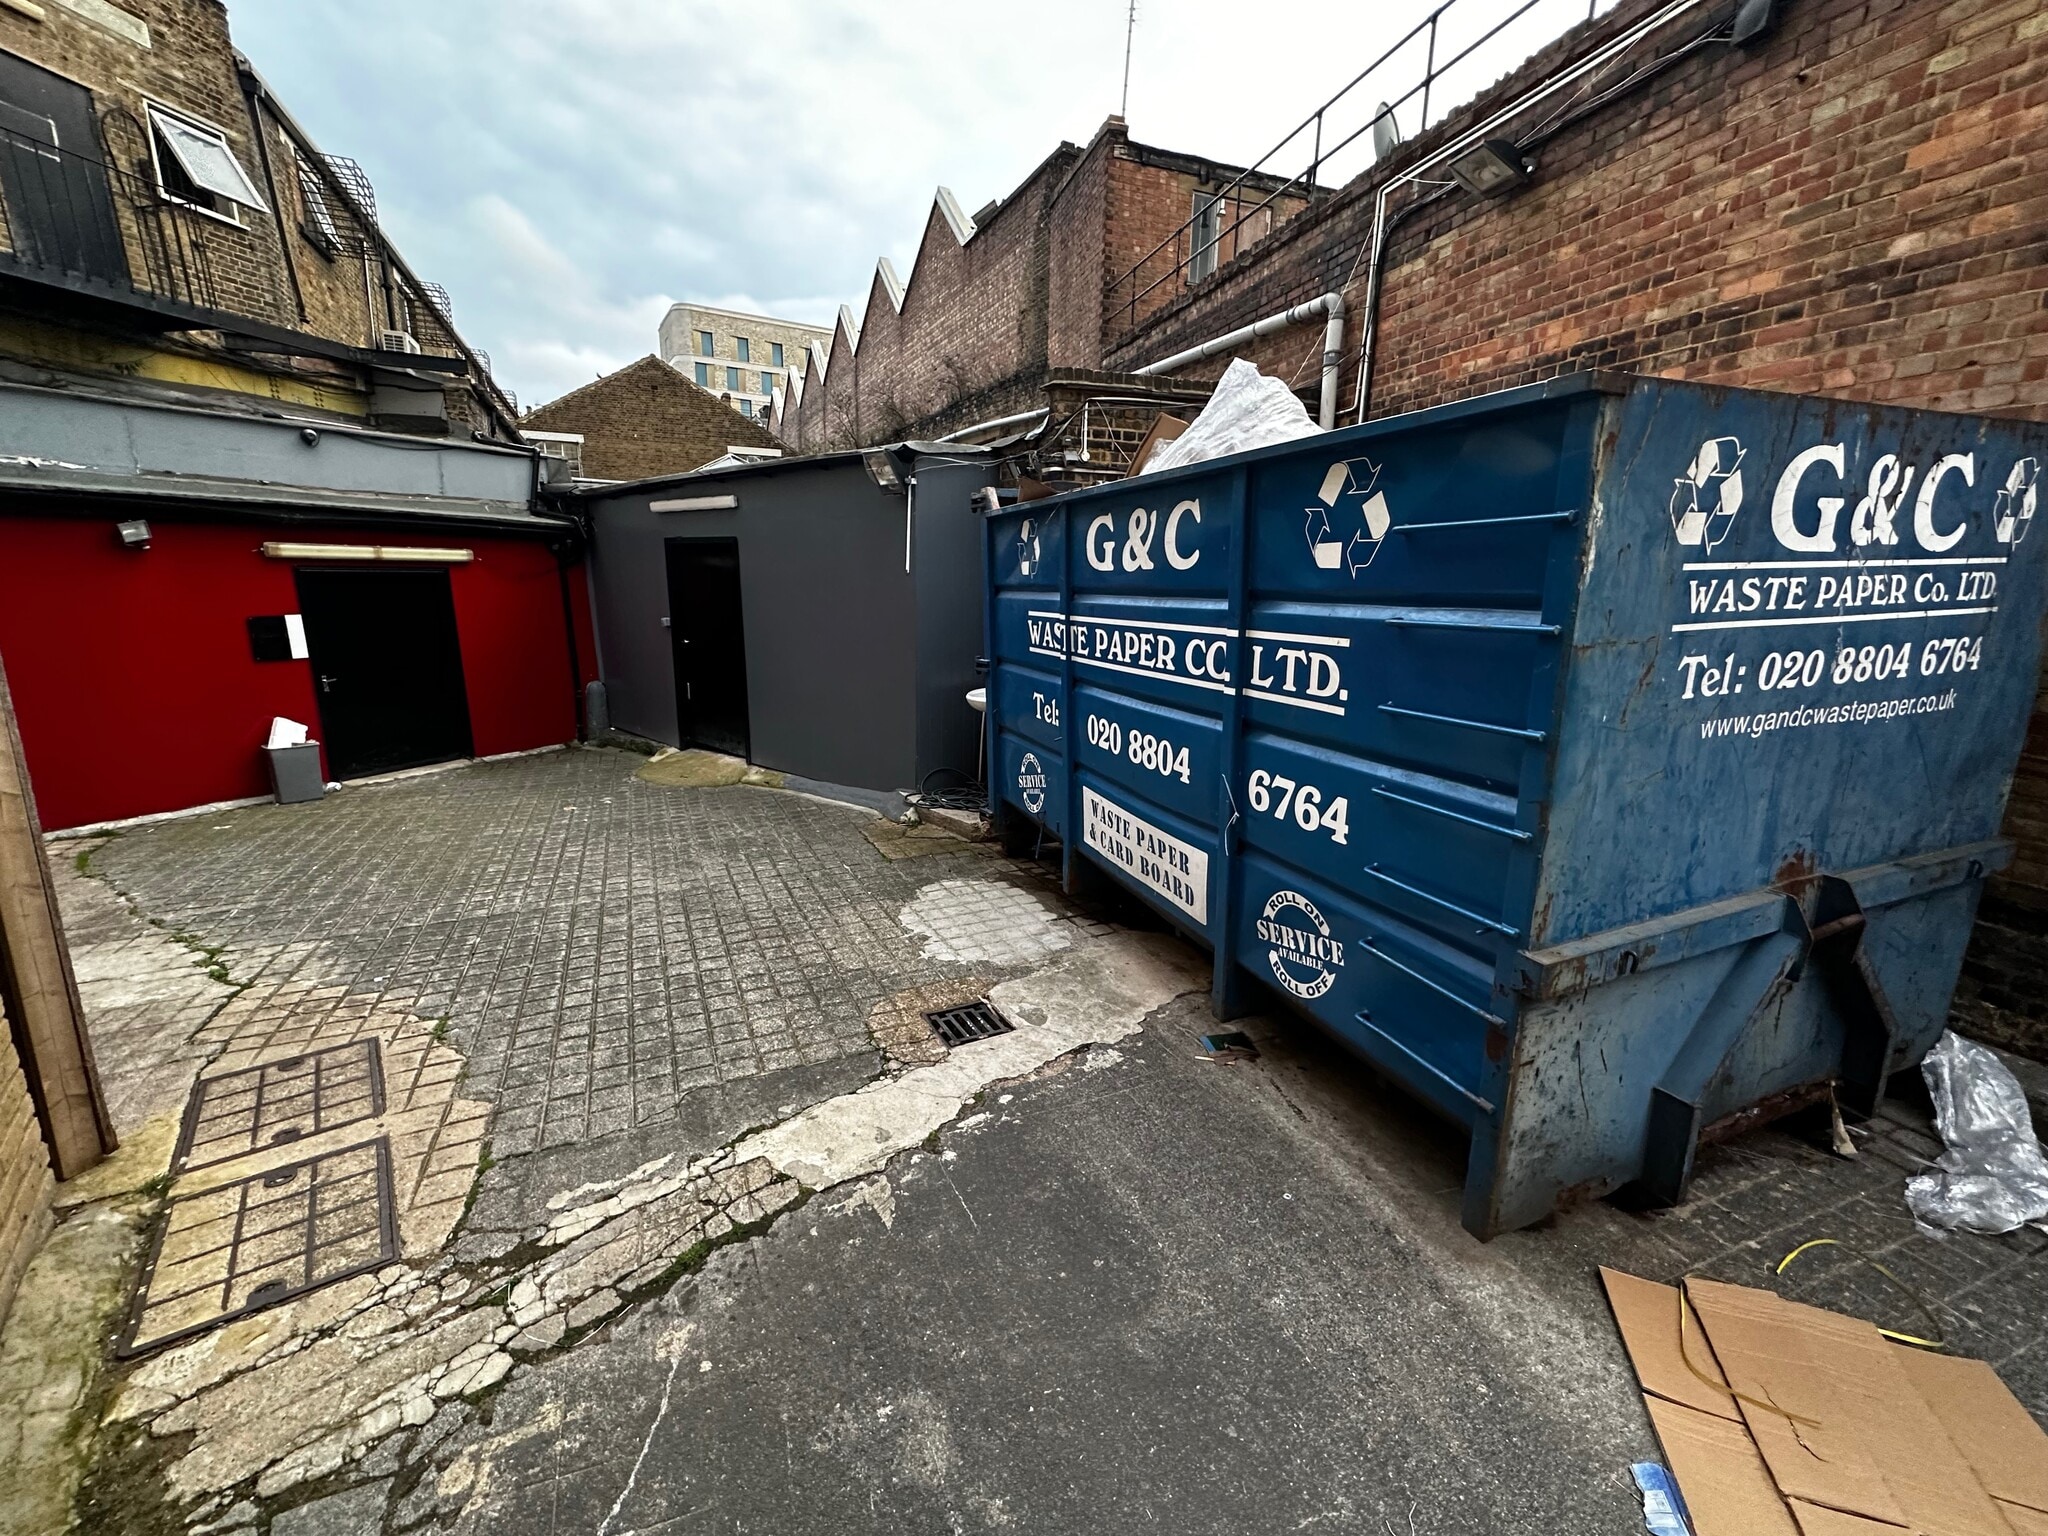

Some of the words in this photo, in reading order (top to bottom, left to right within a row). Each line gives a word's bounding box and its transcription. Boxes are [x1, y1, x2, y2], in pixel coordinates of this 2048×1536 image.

[1771, 442, 1975, 552] G&C
[1086, 498, 1201, 572] G&C
[1688, 576, 1808, 614] WASTE
[1814, 573, 1907, 609] PAPER
[1027, 619, 1090, 657] WASTE
[1095, 628, 1176, 671] PAPER
[1251, 645, 1349, 701] LTD.
[1677, 651, 1746, 700] Tel:
[1758, 648, 1825, 691] 020
[1833, 642, 1913, 685] 8804
[1920, 635, 1983, 677] 6764
[1700, 688, 1957, 740] www.gandcwastepaper.co.uk
[1018, 774, 1047, 788] SERVICE
[1032, 691, 1059, 727] Tel:
[1087, 714, 1122, 756] 020
[1128, 729, 1191, 785] 8804
[1248, 769, 1349, 845] 6764
[1089, 822, 1096, 842] &
[1100, 830, 1134, 867] CARD
[1140, 855, 1194, 907] BOARD
[1091, 799, 1131, 841] WASTE
[1136, 826, 1190, 875] PAPER
[1268, 892, 1300, 912] ROLL
[1304, 902, 1325, 929] ON
[1256, 919, 1345, 967] SERVICE
[1277, 947, 1324, 971] AVAILABLE
[1272, 960, 1303, 996] ROLL
[1305, 975, 1330, 997] OFF
